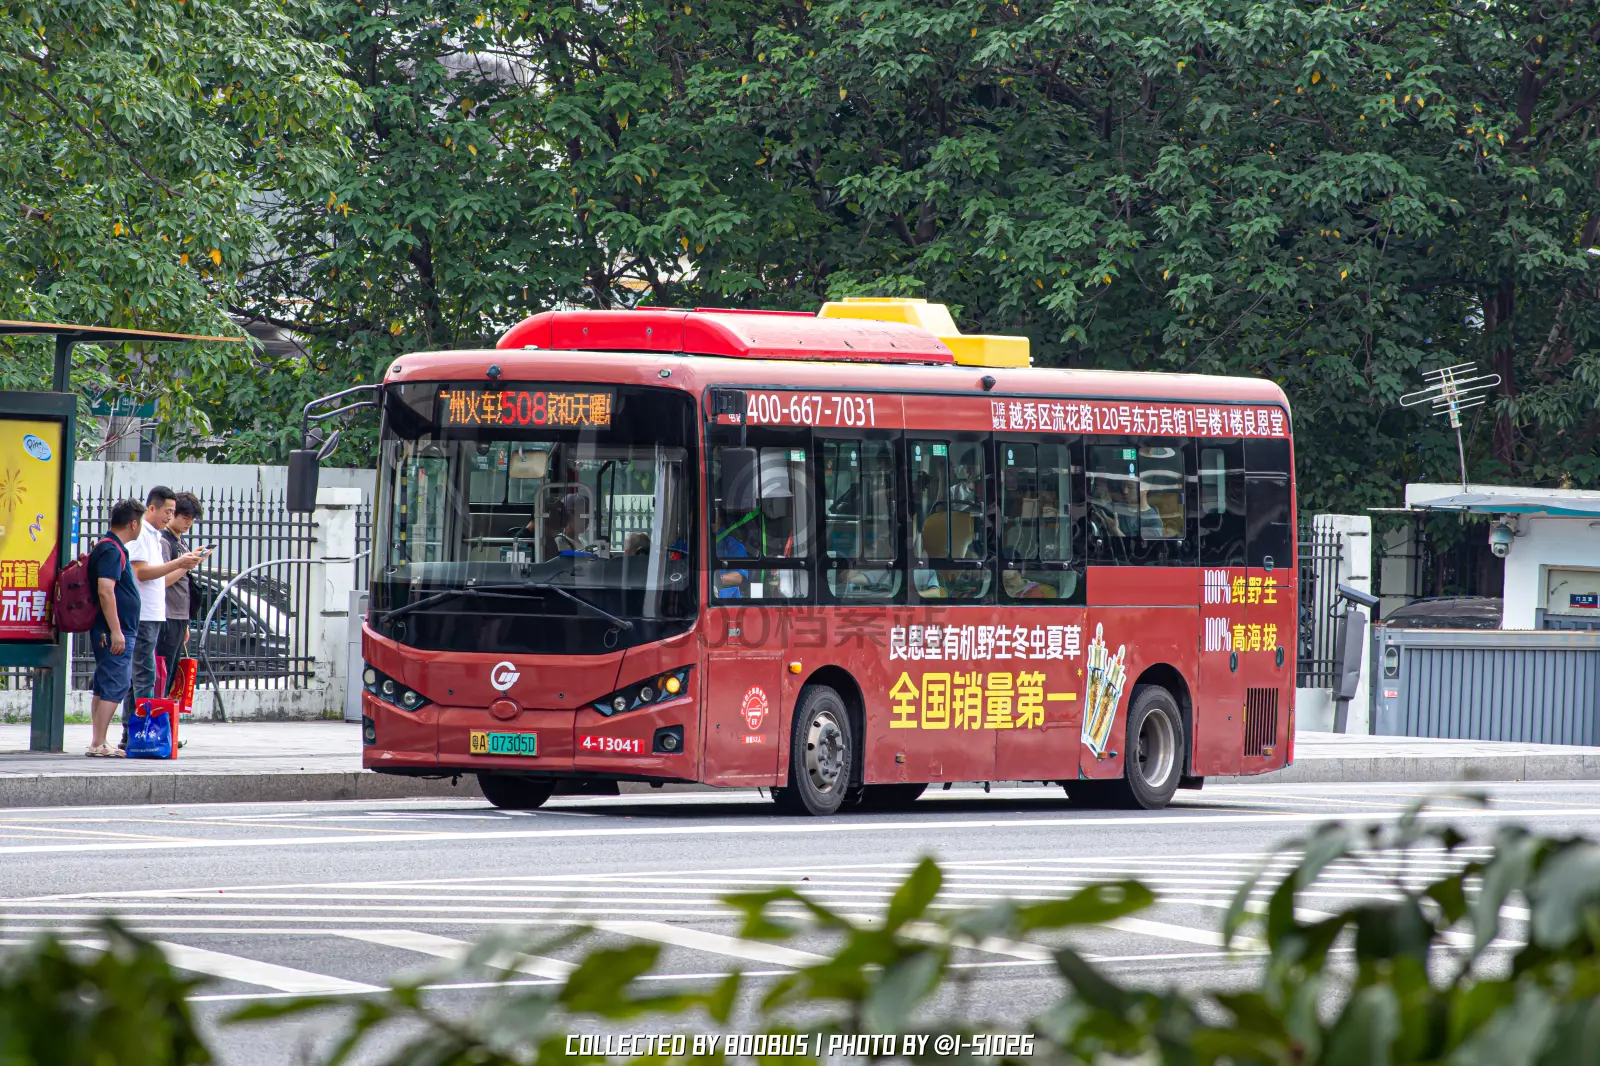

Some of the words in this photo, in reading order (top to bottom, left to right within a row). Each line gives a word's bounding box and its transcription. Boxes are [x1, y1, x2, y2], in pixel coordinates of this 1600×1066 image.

[502, 391, 548, 425] 508
[747, 394, 875, 426] 400-667-7031
[1009, 401, 1285, 437] 越秀区流花路120号东方宾馆1号楼1楼良恩堂
[1, 561, 40, 588] 开盖赢
[1203, 569, 1278, 605] 100%纯野生
[1, 590, 47, 622] 元乐享
[889, 624, 1081, 661] 良恩堂有机野生冬虫夏草
[1204, 617, 1278, 652] 100%高海拔
[889, 670, 1077, 730] 全国销量第一
[582, 736, 640, 753] 4-13041
